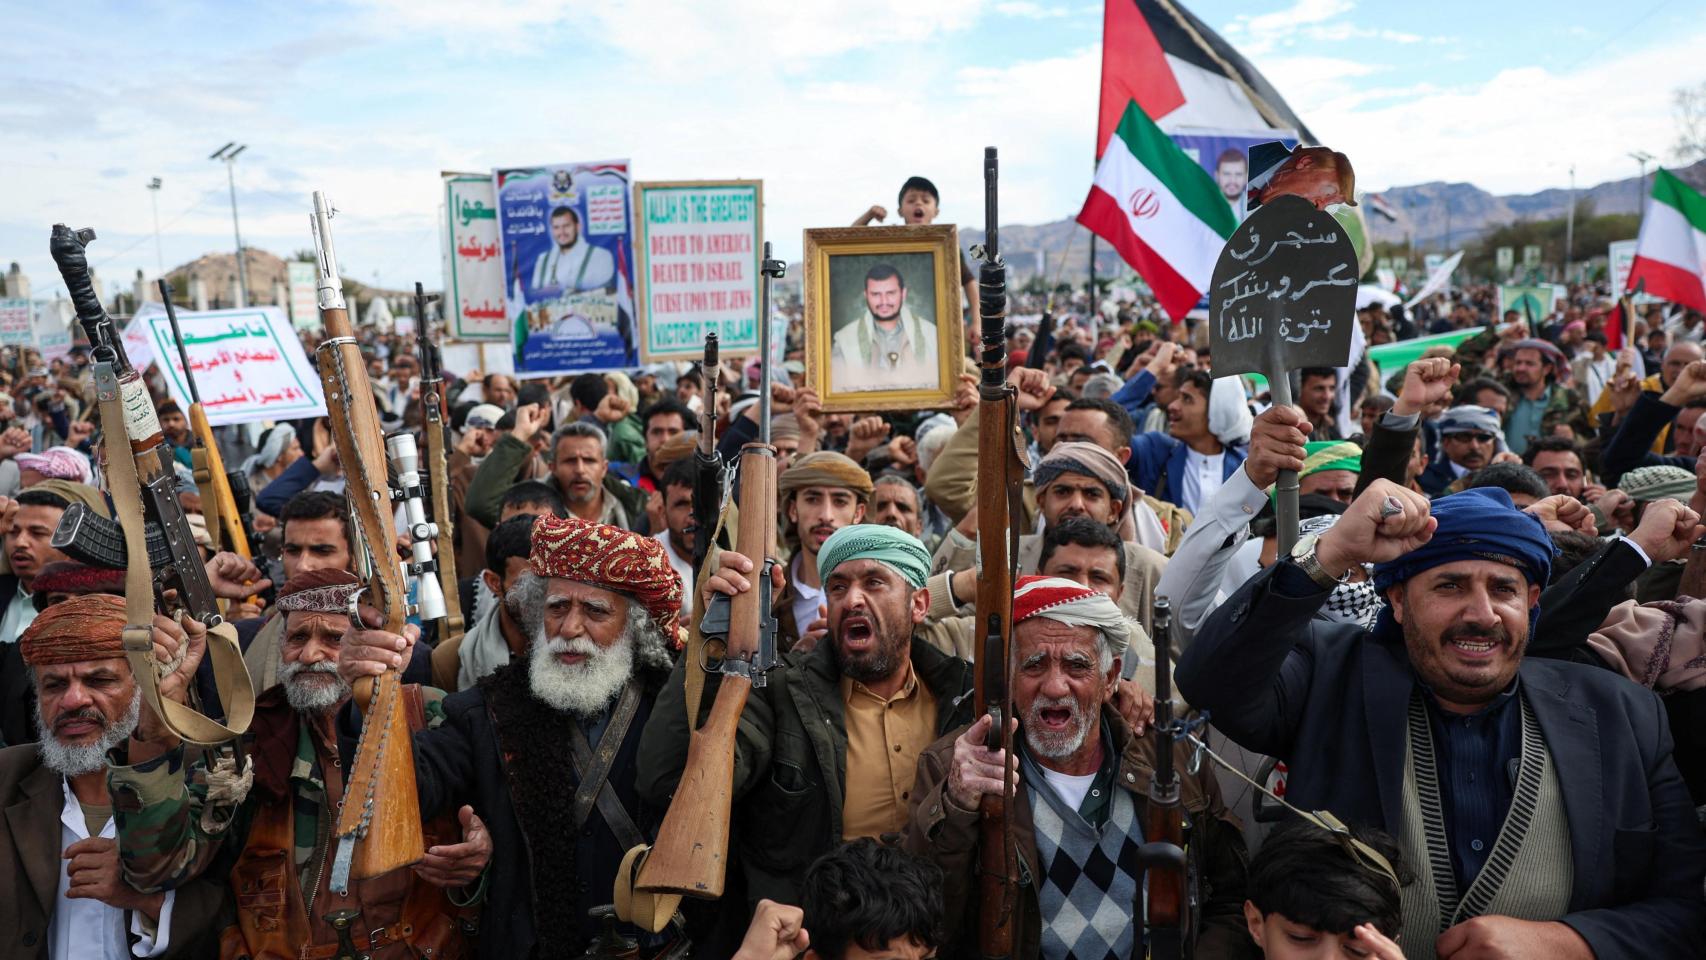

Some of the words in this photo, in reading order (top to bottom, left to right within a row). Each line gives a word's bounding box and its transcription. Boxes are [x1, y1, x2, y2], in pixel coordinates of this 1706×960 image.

[456, 194, 497, 226] عوا
[650, 195, 677, 224] ALLAH
[680, 195, 689, 223] IS
[690, 195, 707, 223] THE
[710, 193, 753, 222] GREATEST
[651, 236, 686, 256] DEATH
[689, 235, 704, 255] TO
[706, 233, 752, 254] AMERICA
[652, 264, 688, 284] DEATH
[691, 263, 704, 283] TO
[706, 261, 743, 282] ISRAEL
[653, 292, 682, 314] CURSE
[684, 292, 708, 313] UPON
[710, 290, 728, 311] THE
[730, 289, 752, 310] JEWS
[655, 322, 701, 346] VICTORY
[723, 319, 753, 341] ISLAM
[1279, 308, 1332, 343] بقوة
[173, 347, 232, 374] الأمريكة
[233, 369, 243, 383] و
